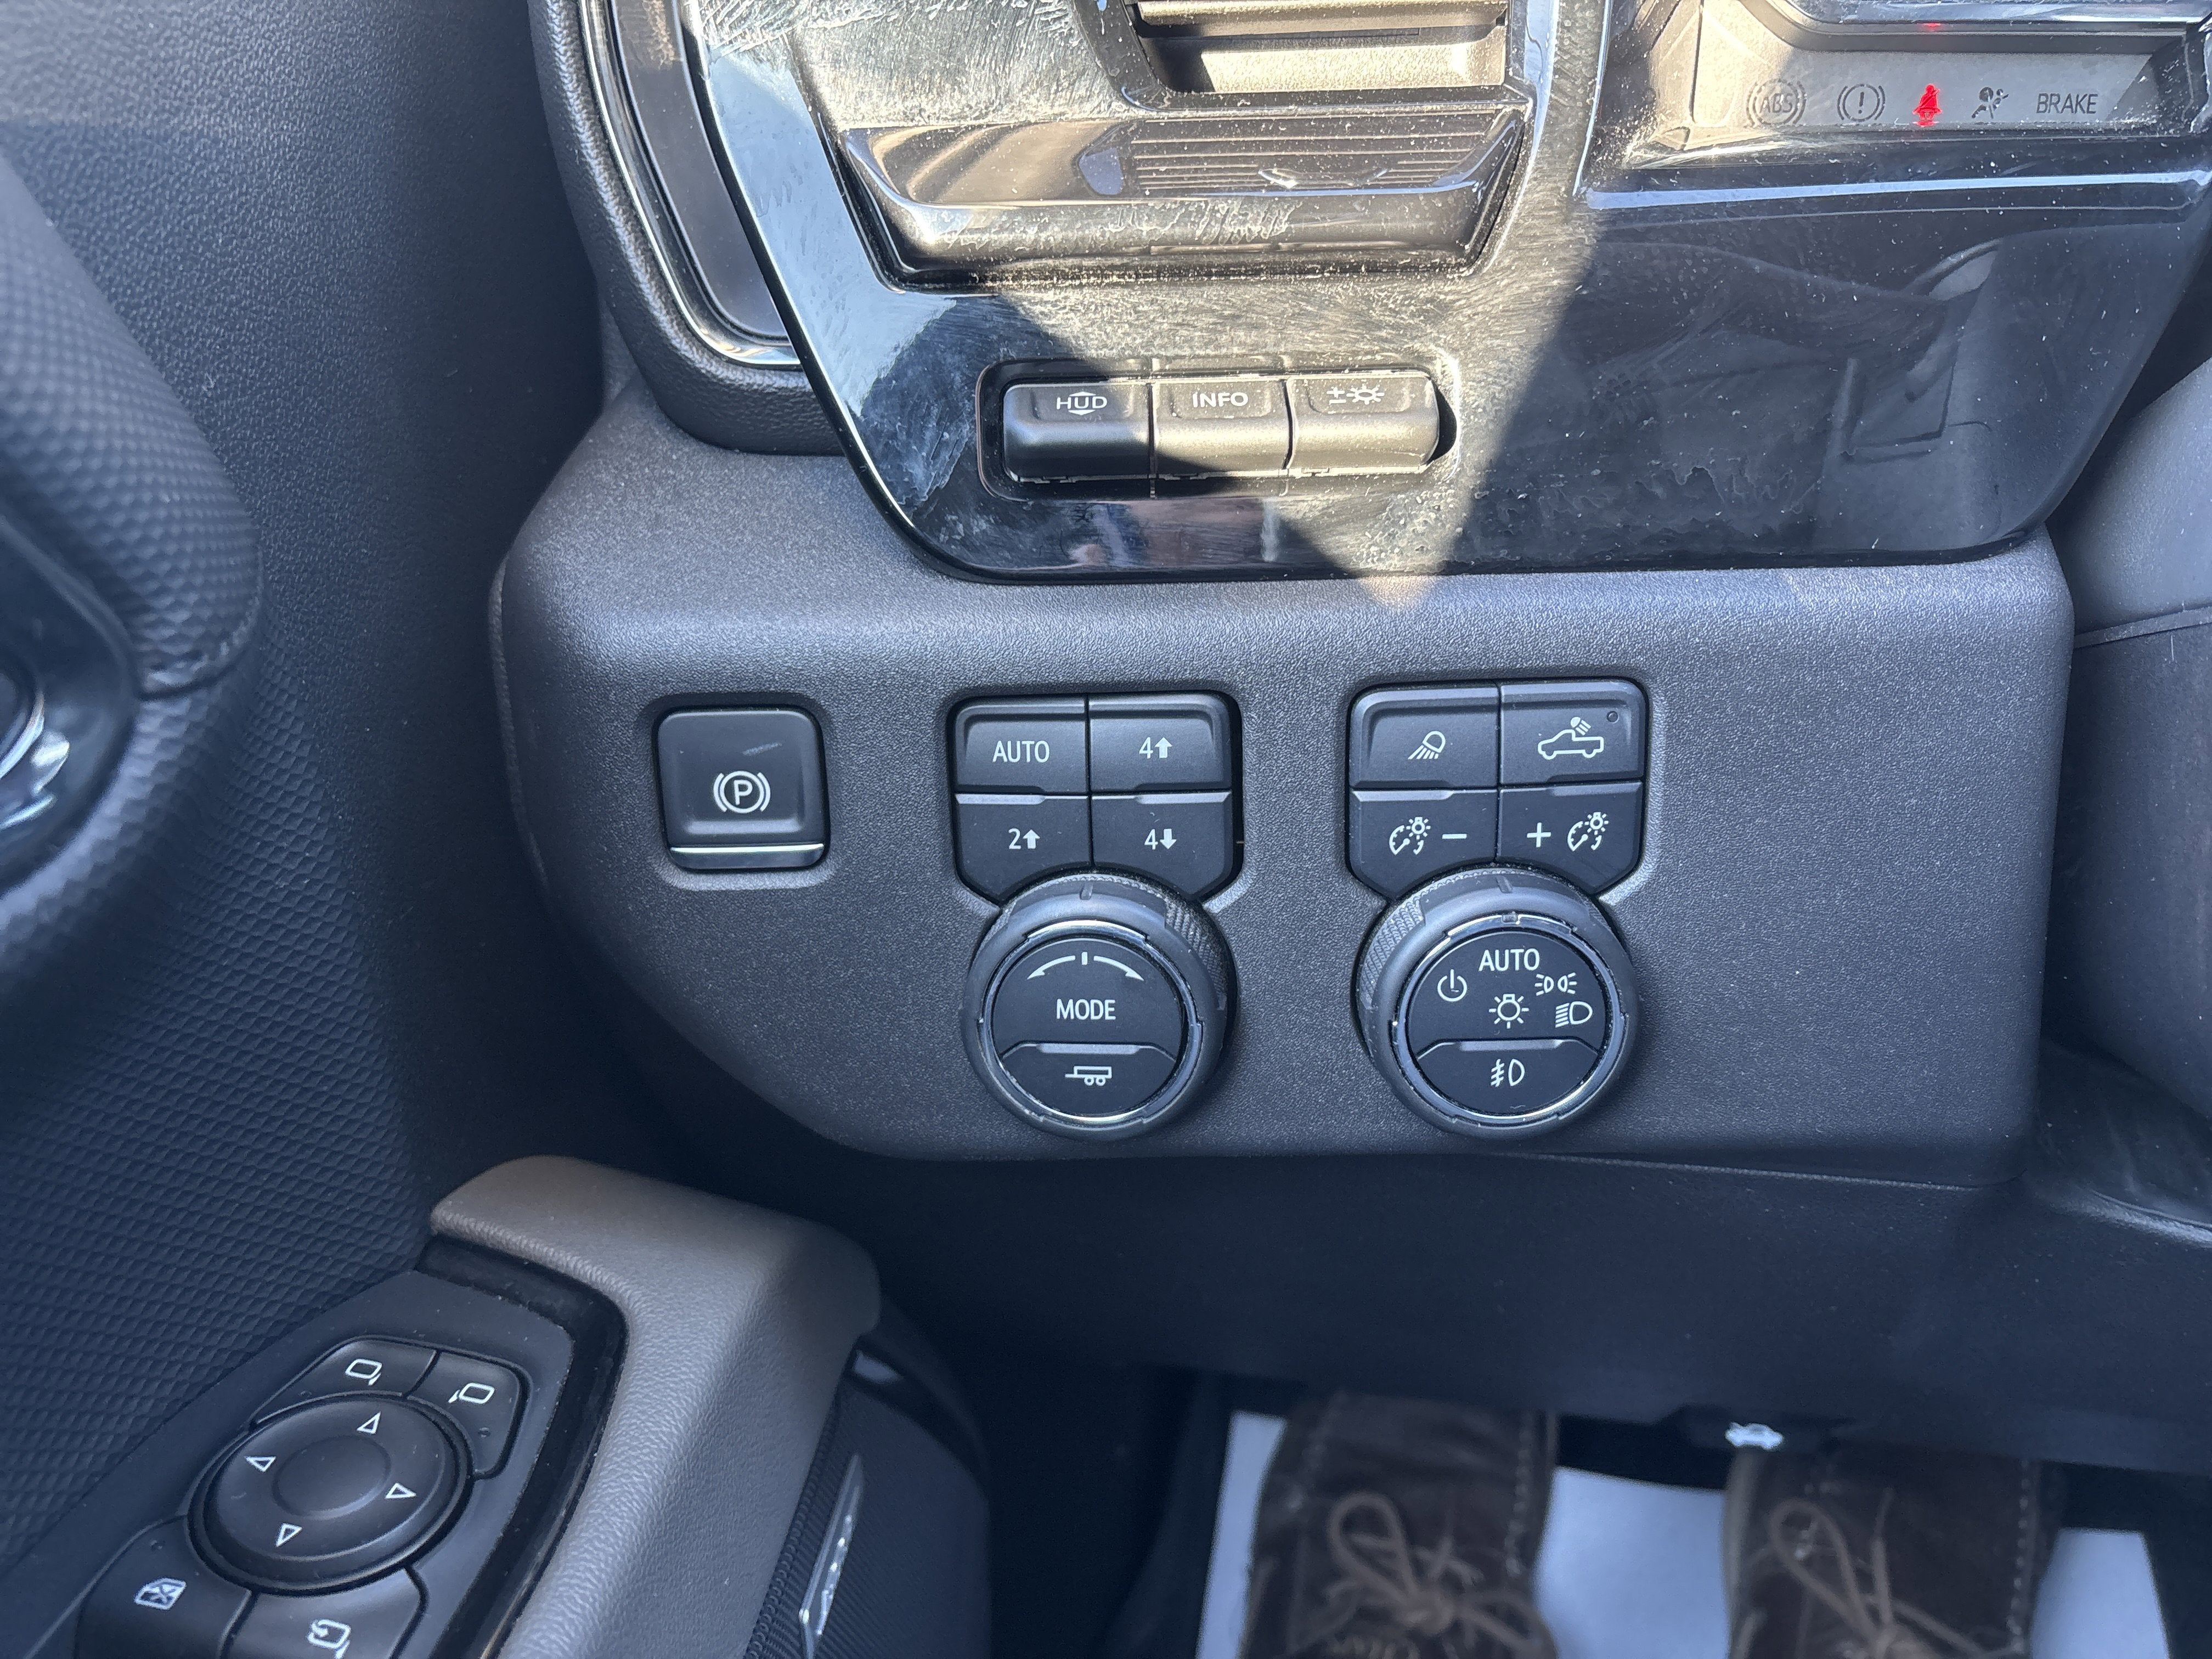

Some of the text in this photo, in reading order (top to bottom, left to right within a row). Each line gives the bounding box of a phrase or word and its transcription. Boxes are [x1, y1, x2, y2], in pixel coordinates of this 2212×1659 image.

[2036, 93, 2098, 115] BRAKE
[1056, 396, 1108, 410] HUD
[1193, 392, 1249, 408] INFO
[992, 740, 1050, 763] AUTO
[733, 779, 753, 805] P
[1479, 947, 1541, 972] AUTO
[1056, 998, 1116, 1020] MODE
